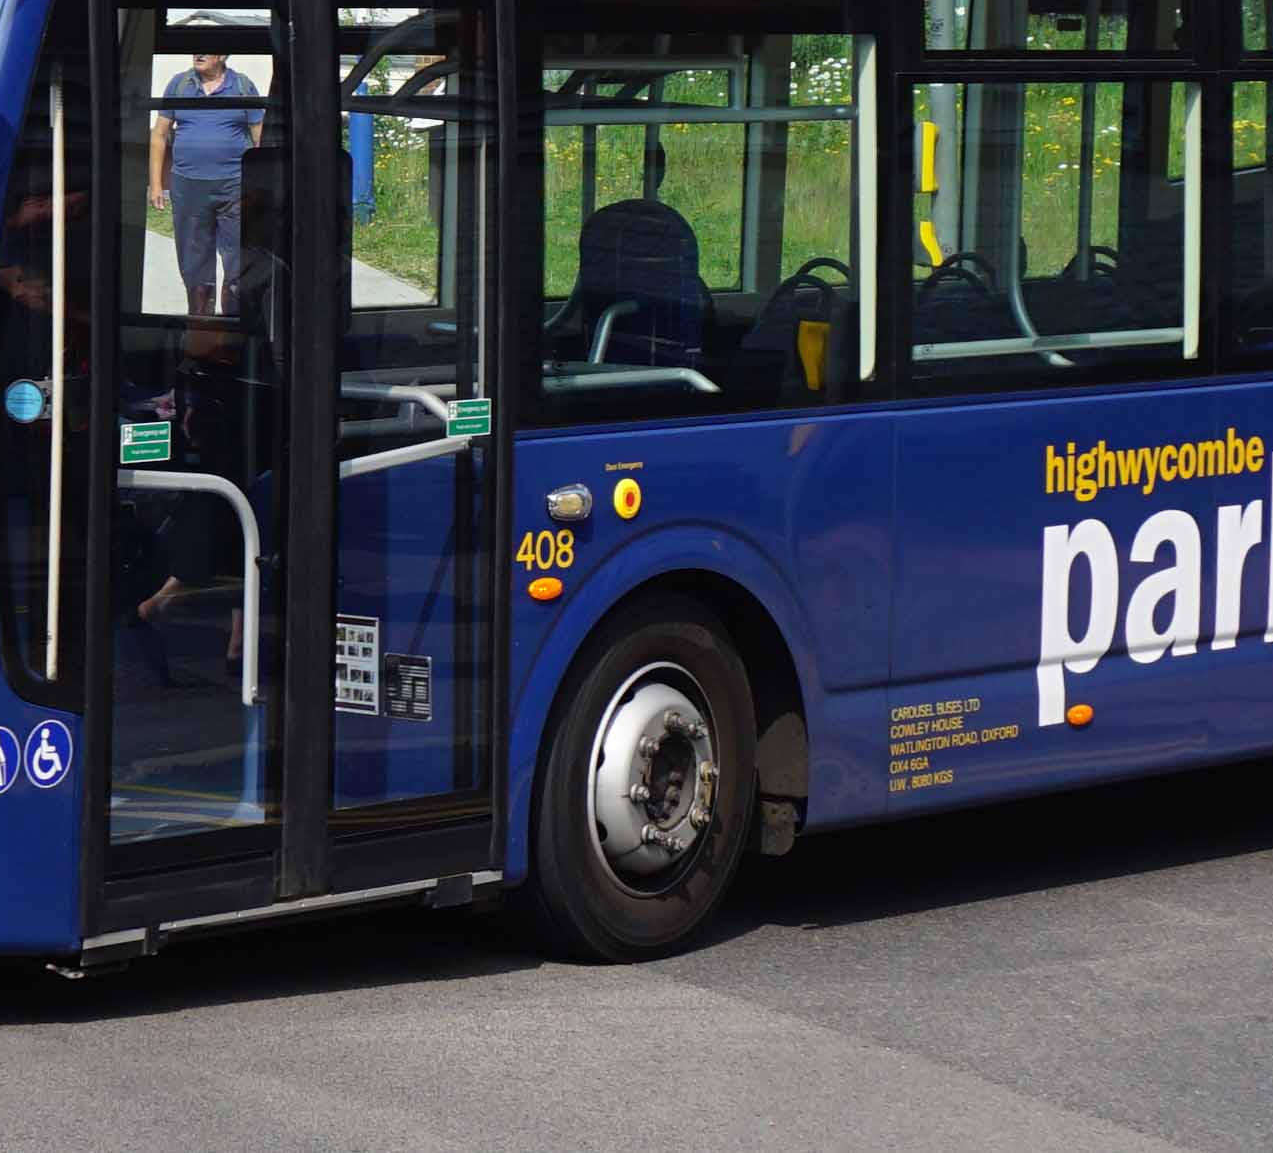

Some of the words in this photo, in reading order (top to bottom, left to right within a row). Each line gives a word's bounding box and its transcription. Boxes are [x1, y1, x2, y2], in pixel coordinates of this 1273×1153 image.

[1046, 427, 1265, 502] highwycombe
[515, 529, 575, 571] 408
[891, 703, 936, 721] CAROUSEL
[964, 698, 981, 712] LTD
[890, 721, 930, 739] COWLEY
[931, 716, 965, 732] HOUSE
[890, 735, 950, 756] WATLINGTON
[981, 725, 1019, 742] OXFORD
